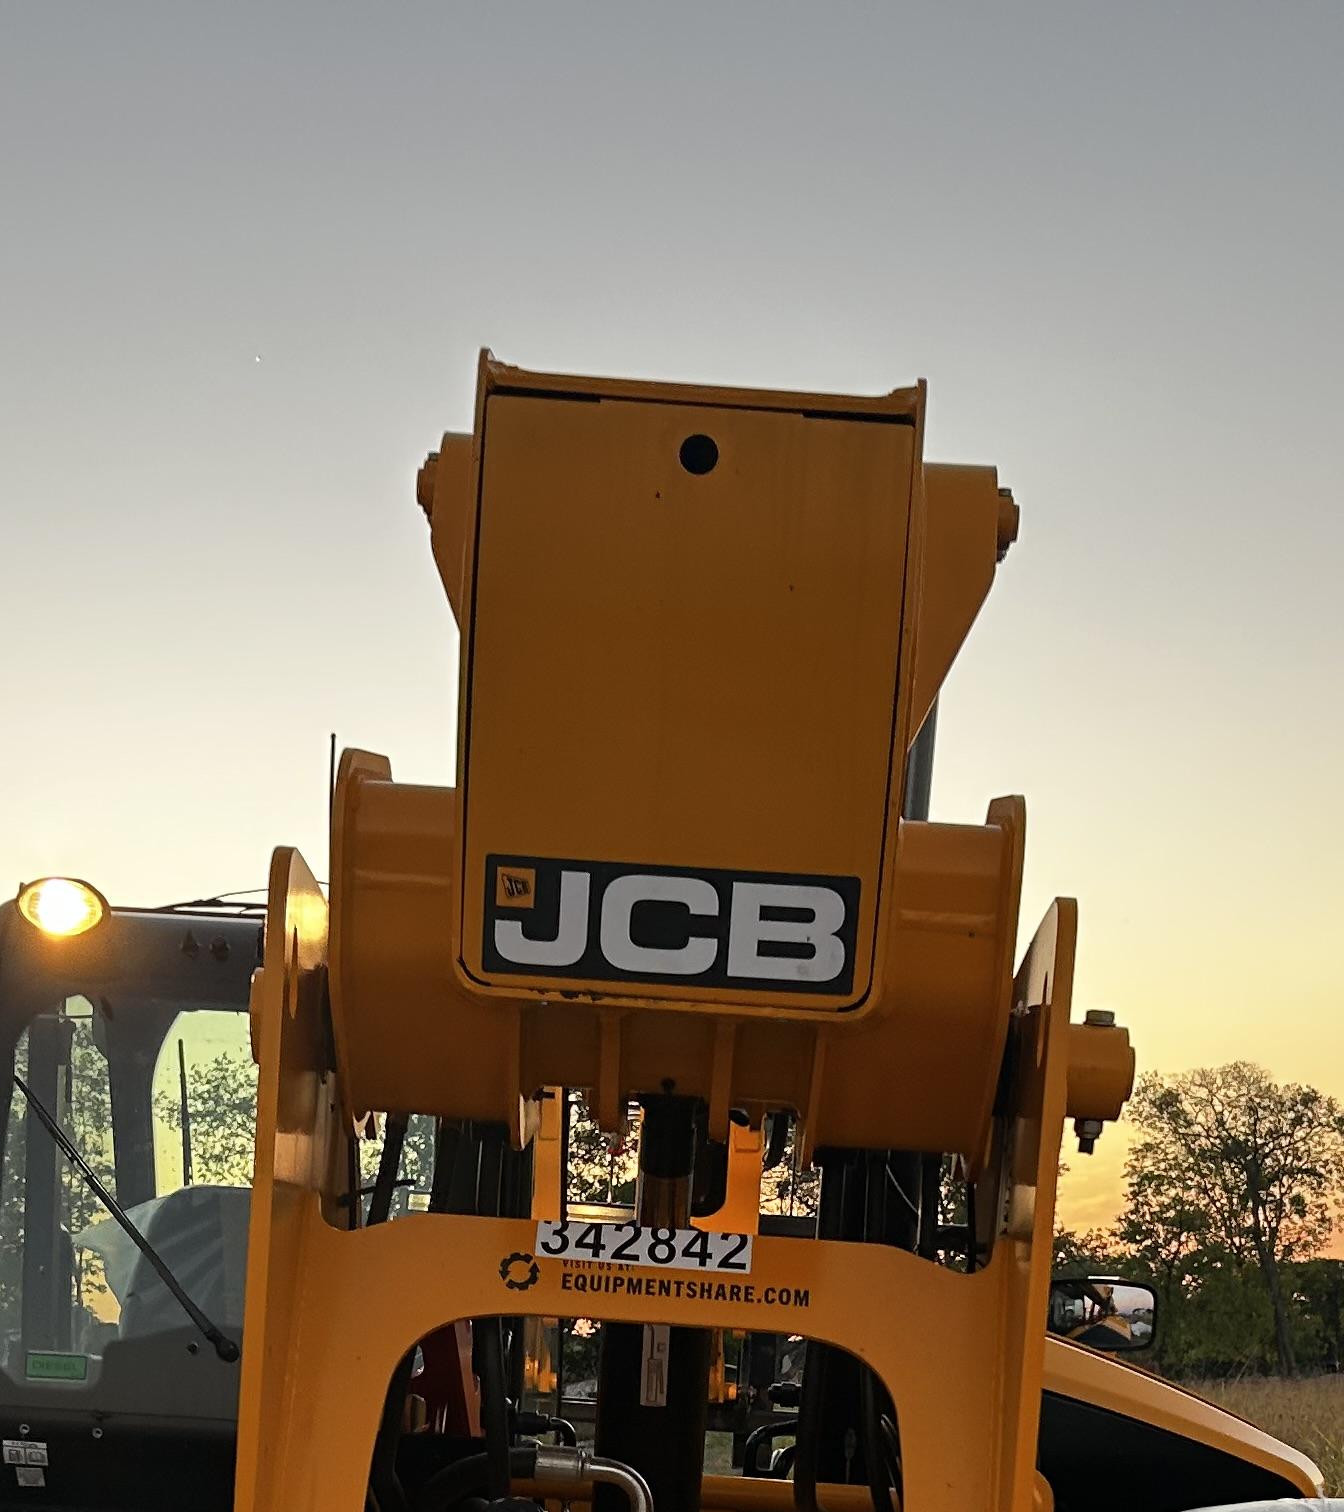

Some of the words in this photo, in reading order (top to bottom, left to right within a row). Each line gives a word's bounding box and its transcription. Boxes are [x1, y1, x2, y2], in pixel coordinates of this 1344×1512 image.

[494, 870, 845, 982] JCB
[541, 1220, 748, 1270] 342842
[562, 1259, 592, 1269] VISIT
[598, 1261, 612, 1271] US
[561, 1273, 810, 1307] EQUIPMENTSHARE.COM
